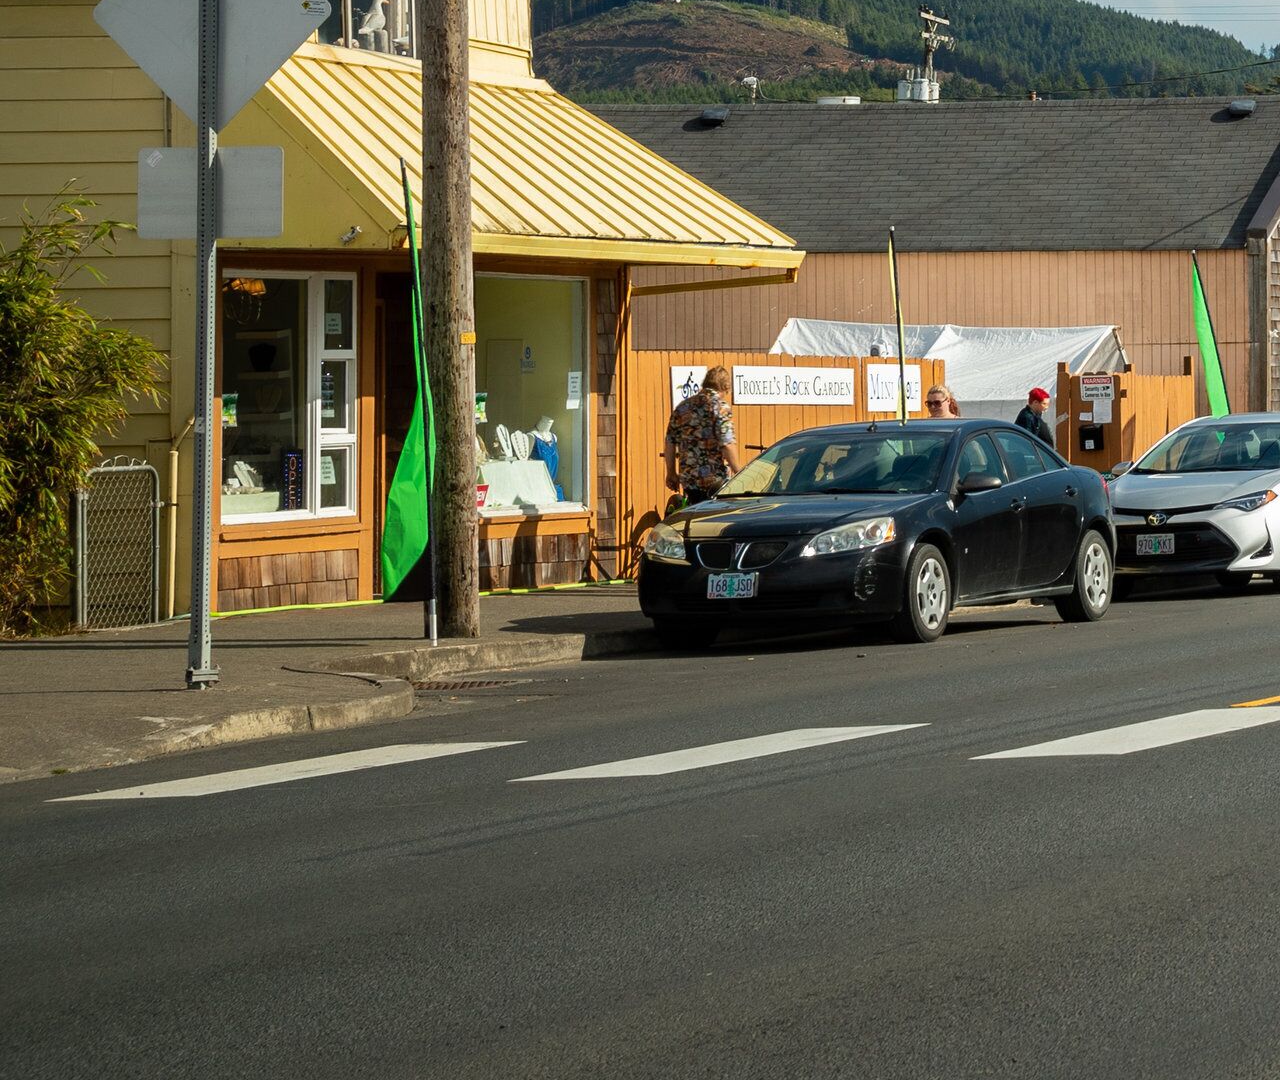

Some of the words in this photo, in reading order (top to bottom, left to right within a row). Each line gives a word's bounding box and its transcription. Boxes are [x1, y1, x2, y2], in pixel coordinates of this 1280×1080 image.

[735, 374, 781, 396] TROXEL'S
[784, 374, 810, 396] ROCK
[812, 374, 852, 397] GARDEN
[869, 373, 894, 400] MINI
[710, 579, 728, 593] 168
